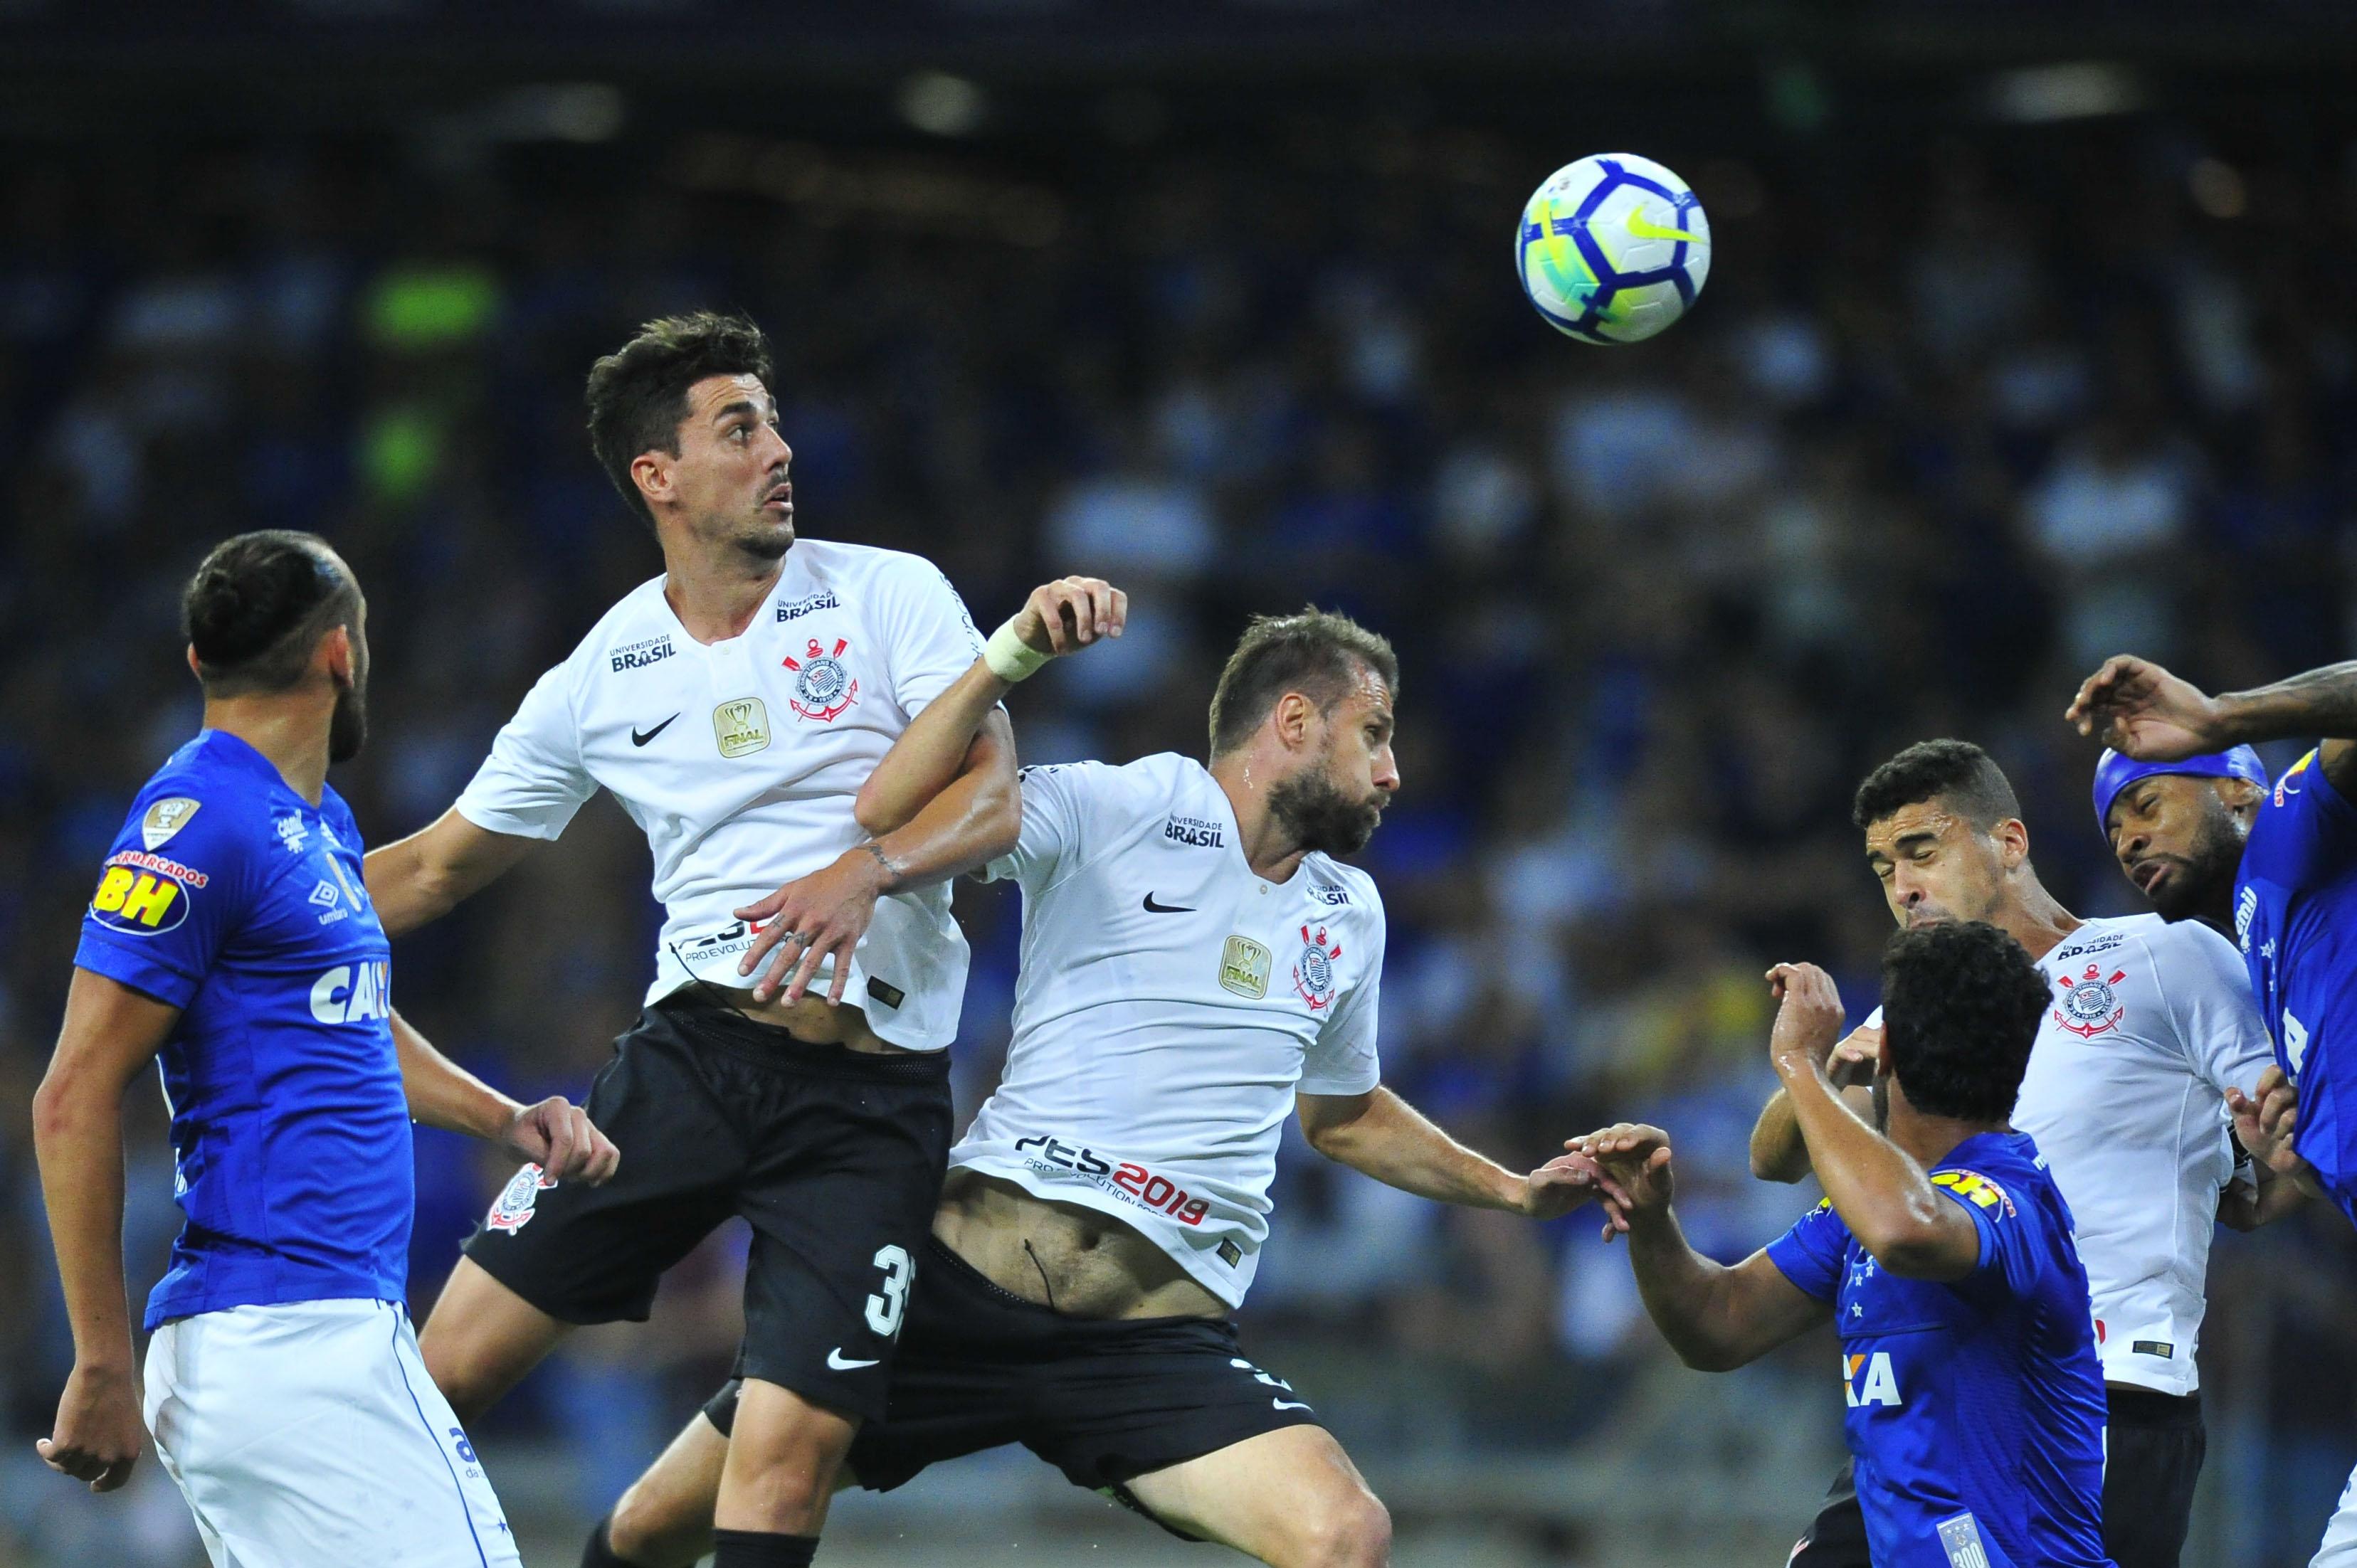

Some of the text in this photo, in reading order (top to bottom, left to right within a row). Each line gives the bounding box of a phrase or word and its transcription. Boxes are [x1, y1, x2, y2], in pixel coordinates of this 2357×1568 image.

[776, 595, 840, 623] BRASIL
[610, 634, 671, 656] UNIVERSIDADE
[612, 642, 676, 673] BRASIL
[724, 729, 764, 747] FINAL
[1164, 820, 1225, 848] BRASIL
[93, 866, 179, 927] BH
[686, 938, 756, 963] PRO EVOLU
[1226, 965, 1261, 989] FINAL
[1024, 1158, 1053, 1172] PRO
[1112, 1162, 1209, 1226] 2019
